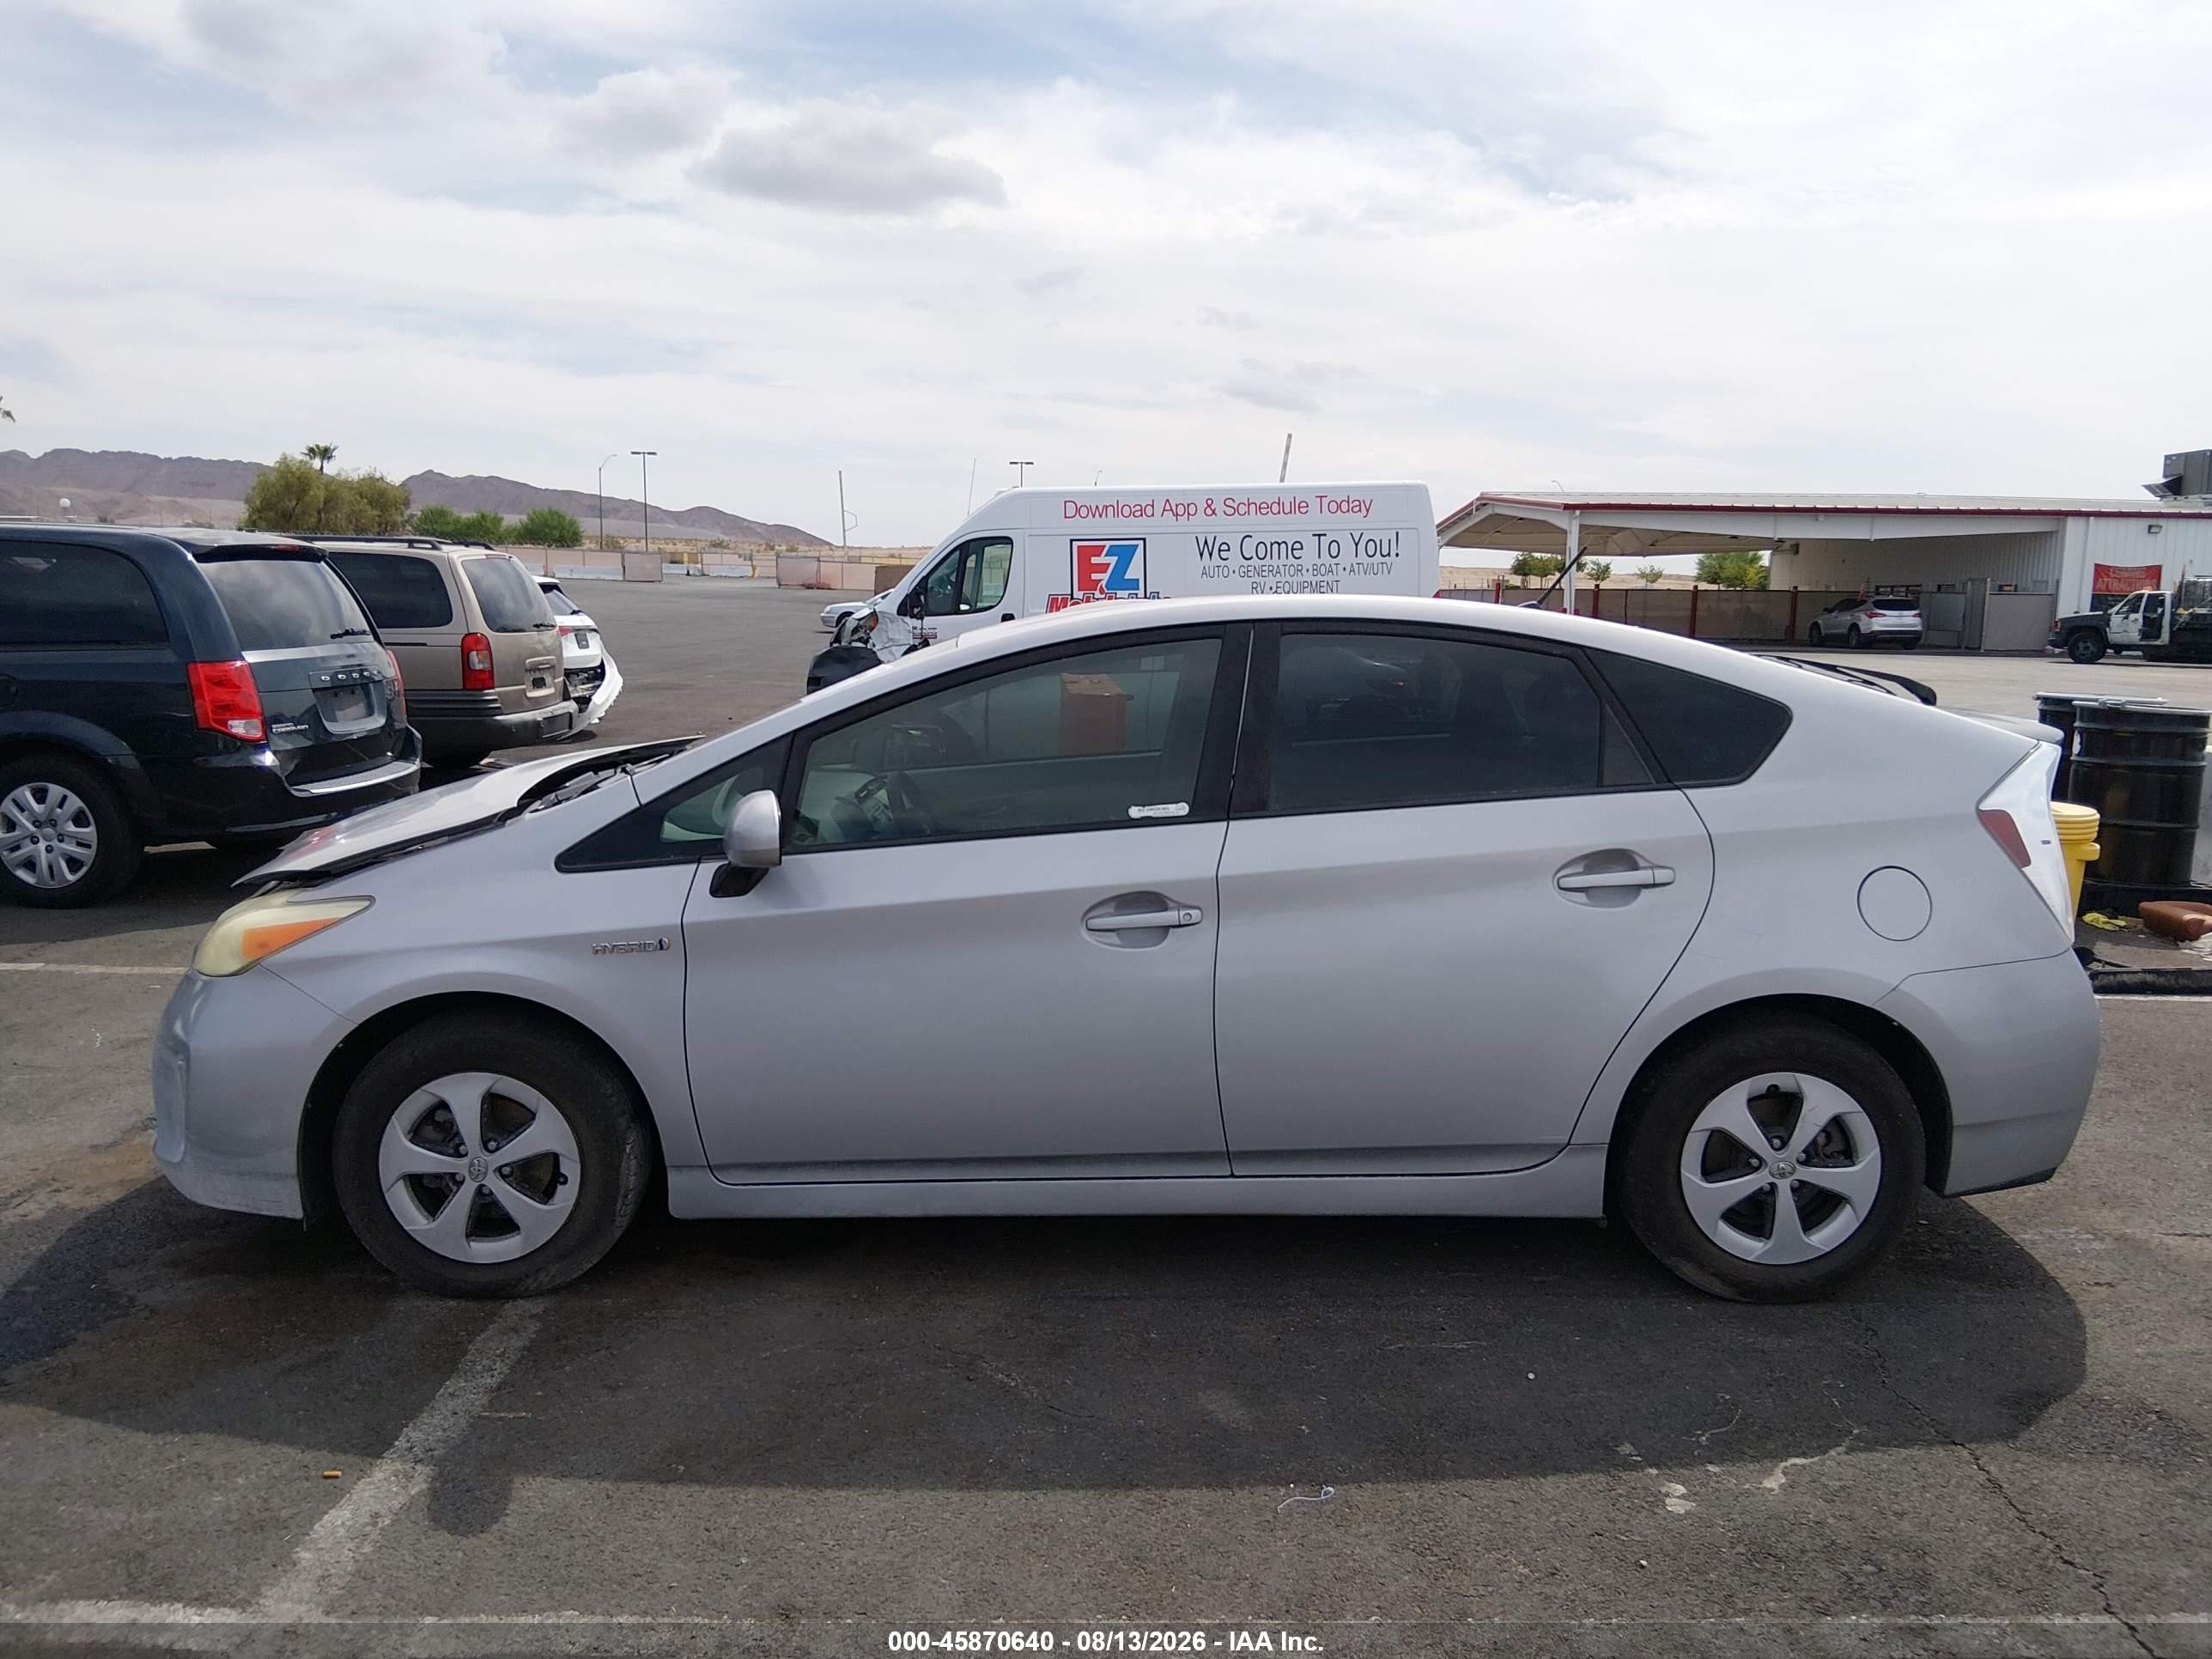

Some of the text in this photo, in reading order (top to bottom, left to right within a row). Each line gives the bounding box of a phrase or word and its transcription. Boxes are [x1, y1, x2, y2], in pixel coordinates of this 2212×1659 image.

[1064, 495, 1373, 521] Download App & Schedule Today
[1195, 532, 1400, 562] We Come To You!
[1077, 544, 1139, 592] EZ
[1201, 562, 1393, 578] AUTO GENERATOR BOAT ATV/UTV
[1251, 580, 1340, 595] RV EQUIPMENT
[592, 940, 658, 955] HYBRID
